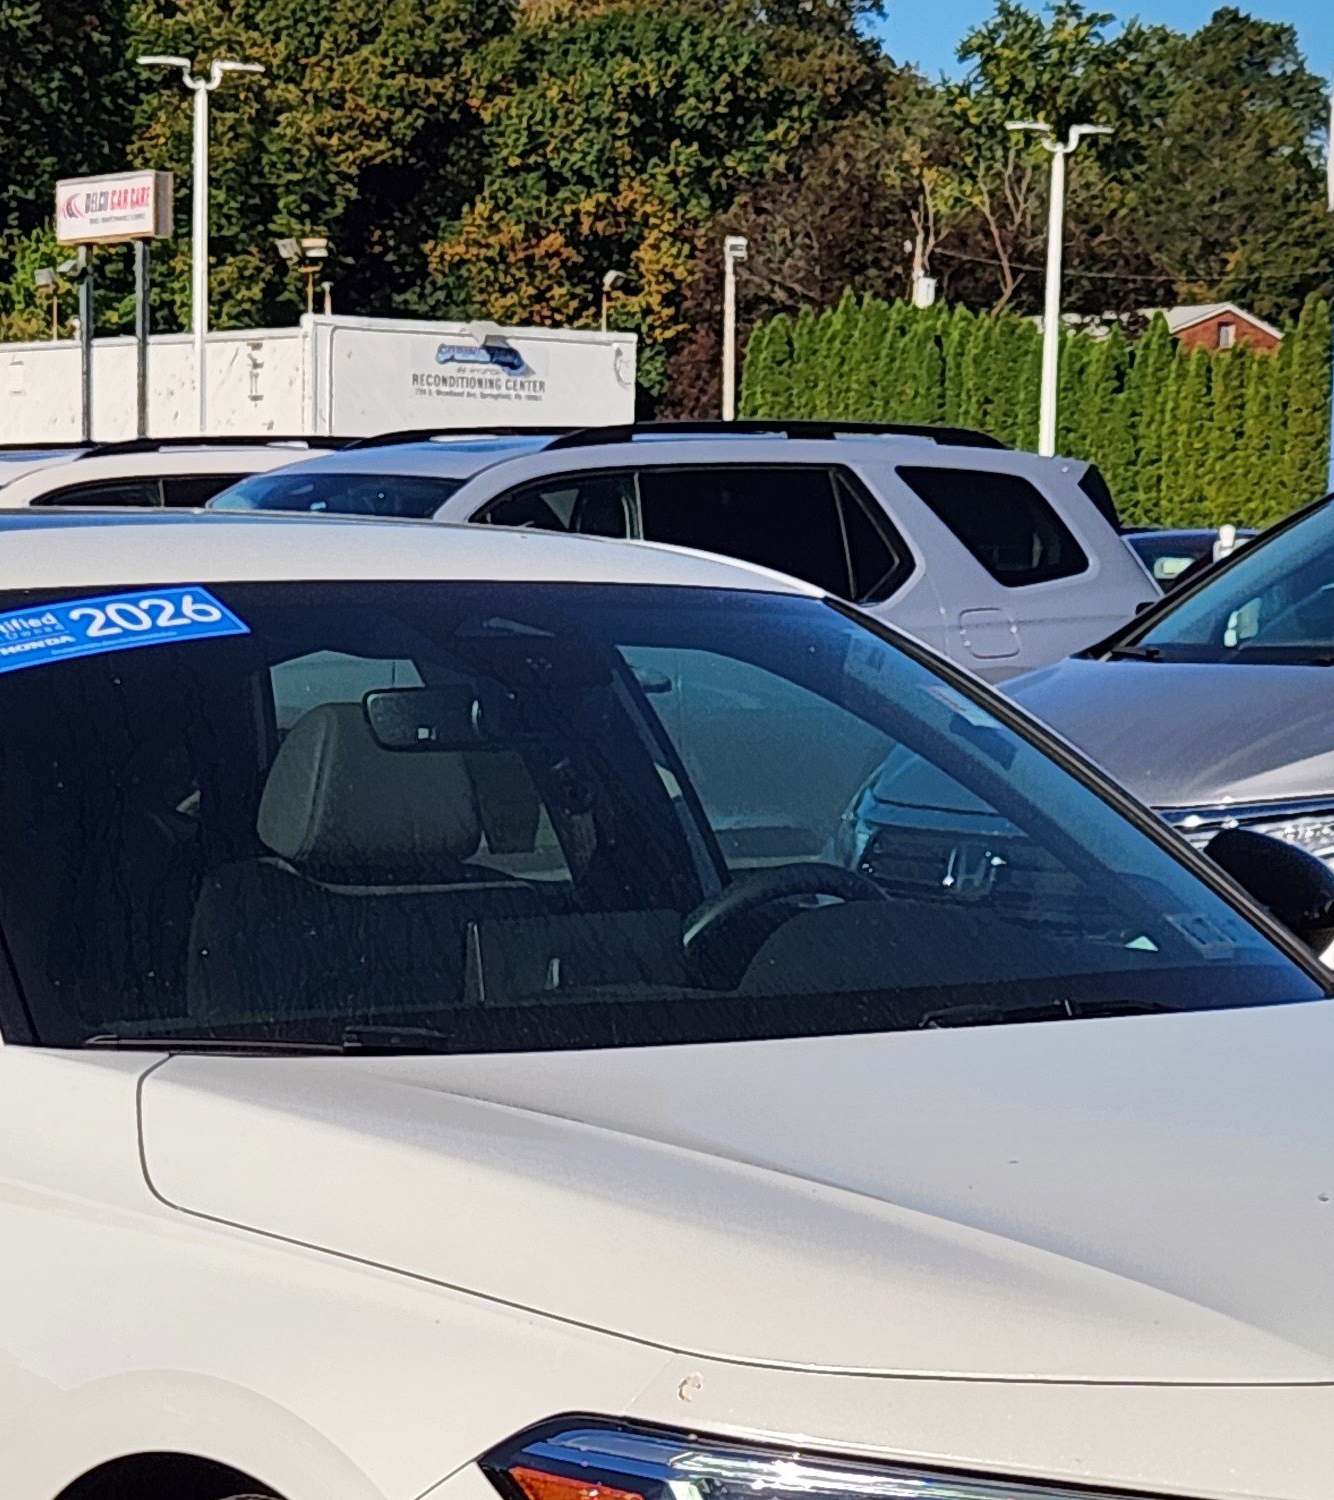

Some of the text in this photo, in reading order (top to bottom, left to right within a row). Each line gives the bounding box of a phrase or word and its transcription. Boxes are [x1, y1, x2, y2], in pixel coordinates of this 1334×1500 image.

[412, 373, 545, 393] RECONDITIONING CENTER
[69, 595, 222, 637] 2026
